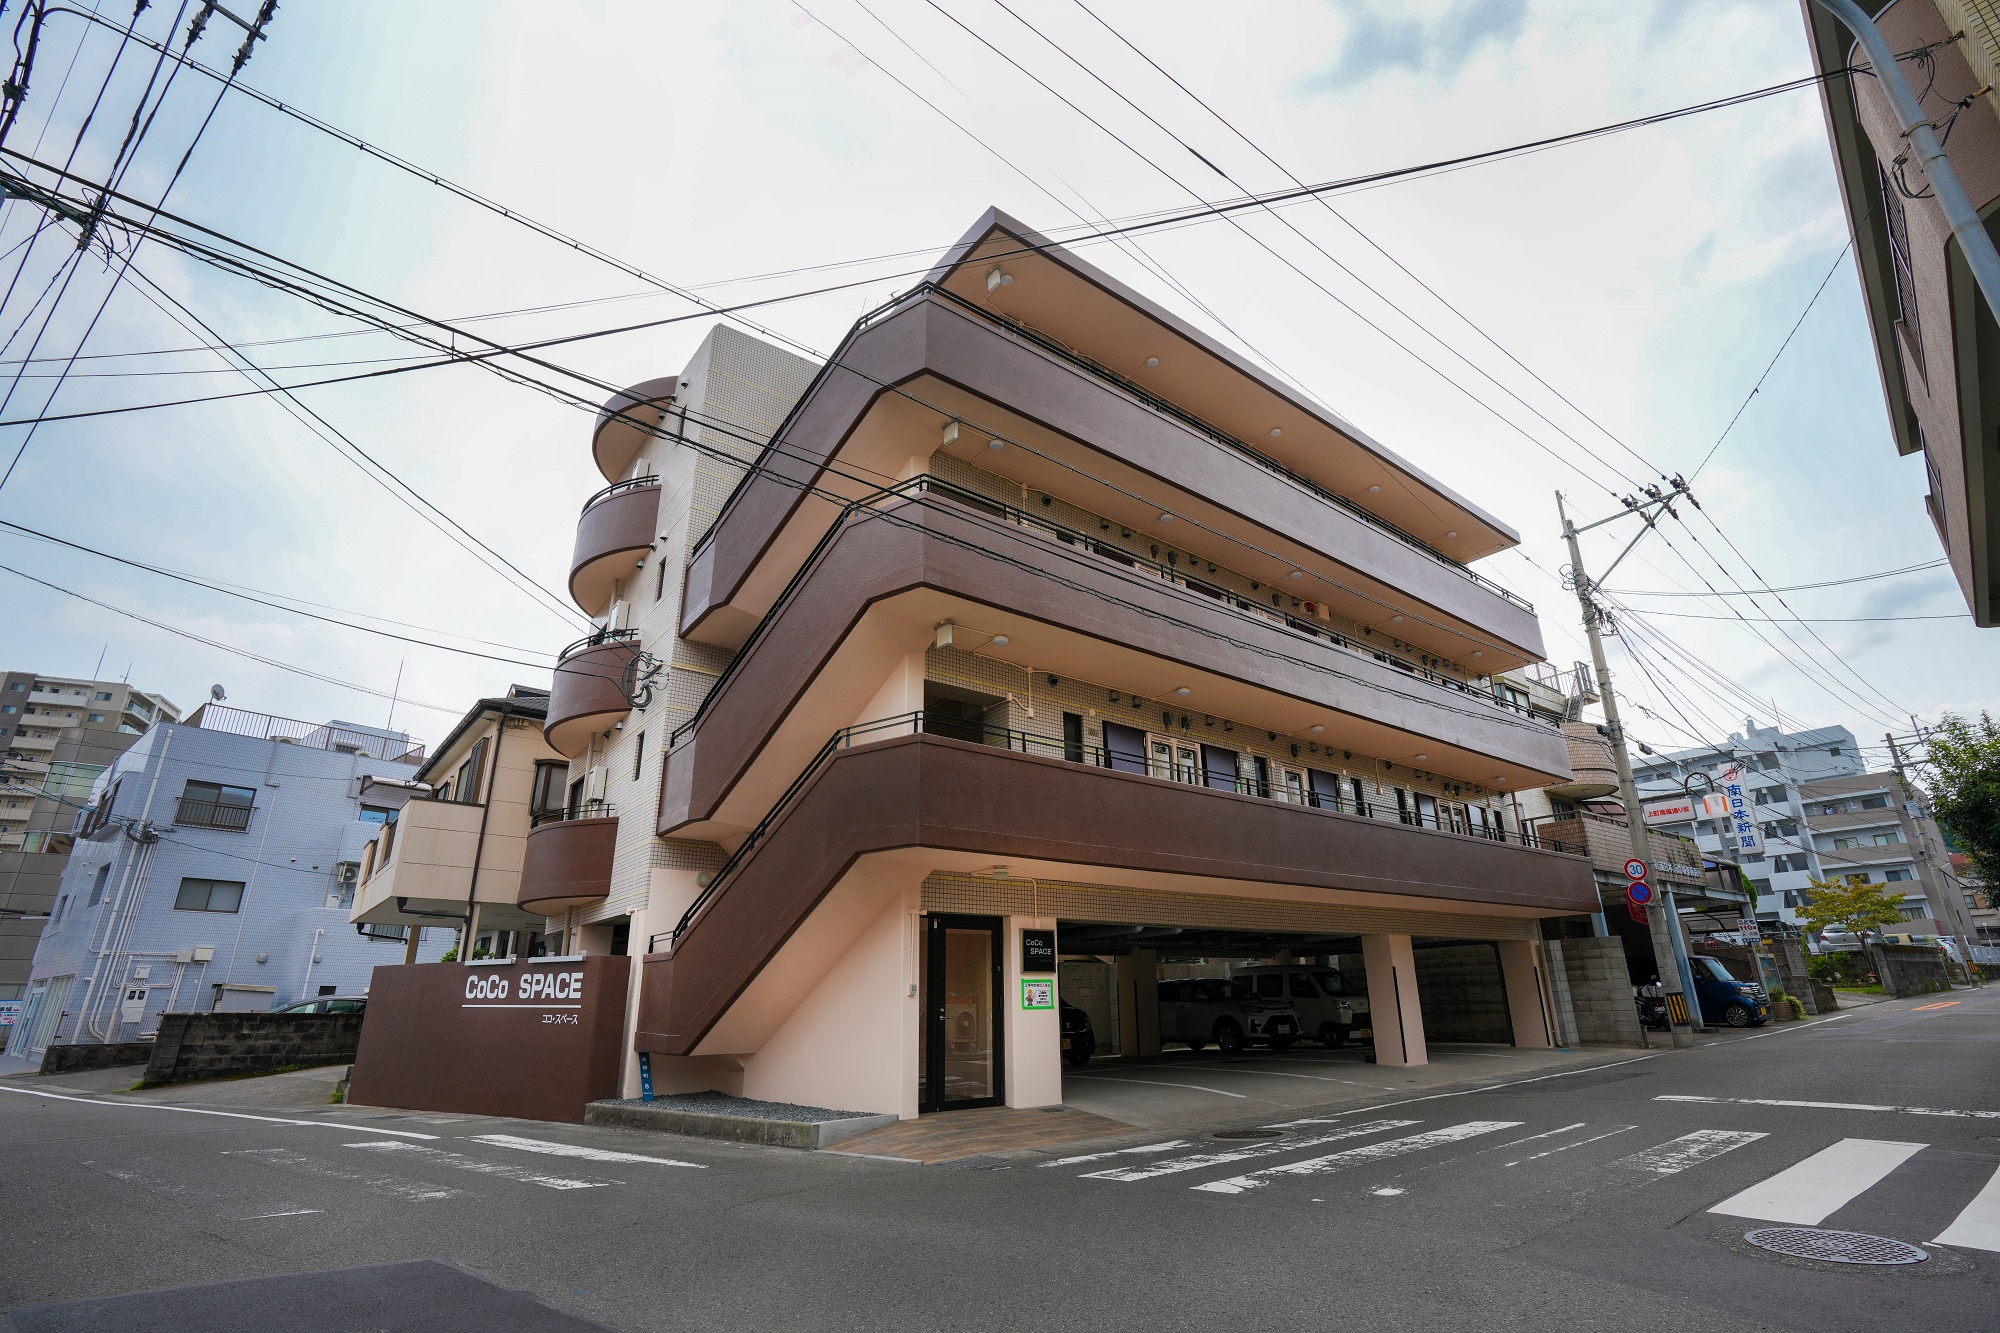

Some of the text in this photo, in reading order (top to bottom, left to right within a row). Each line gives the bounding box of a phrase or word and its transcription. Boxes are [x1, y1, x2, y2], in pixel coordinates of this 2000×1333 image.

[1727, 783, 1756, 847] 南日本新聞
[1629, 864, 1643, 875] 30
[1025, 938, 1043, 946] CoCo
[1030, 947, 1052, 955] SPACE
[465, 972, 584, 999] CoCo SPACE
